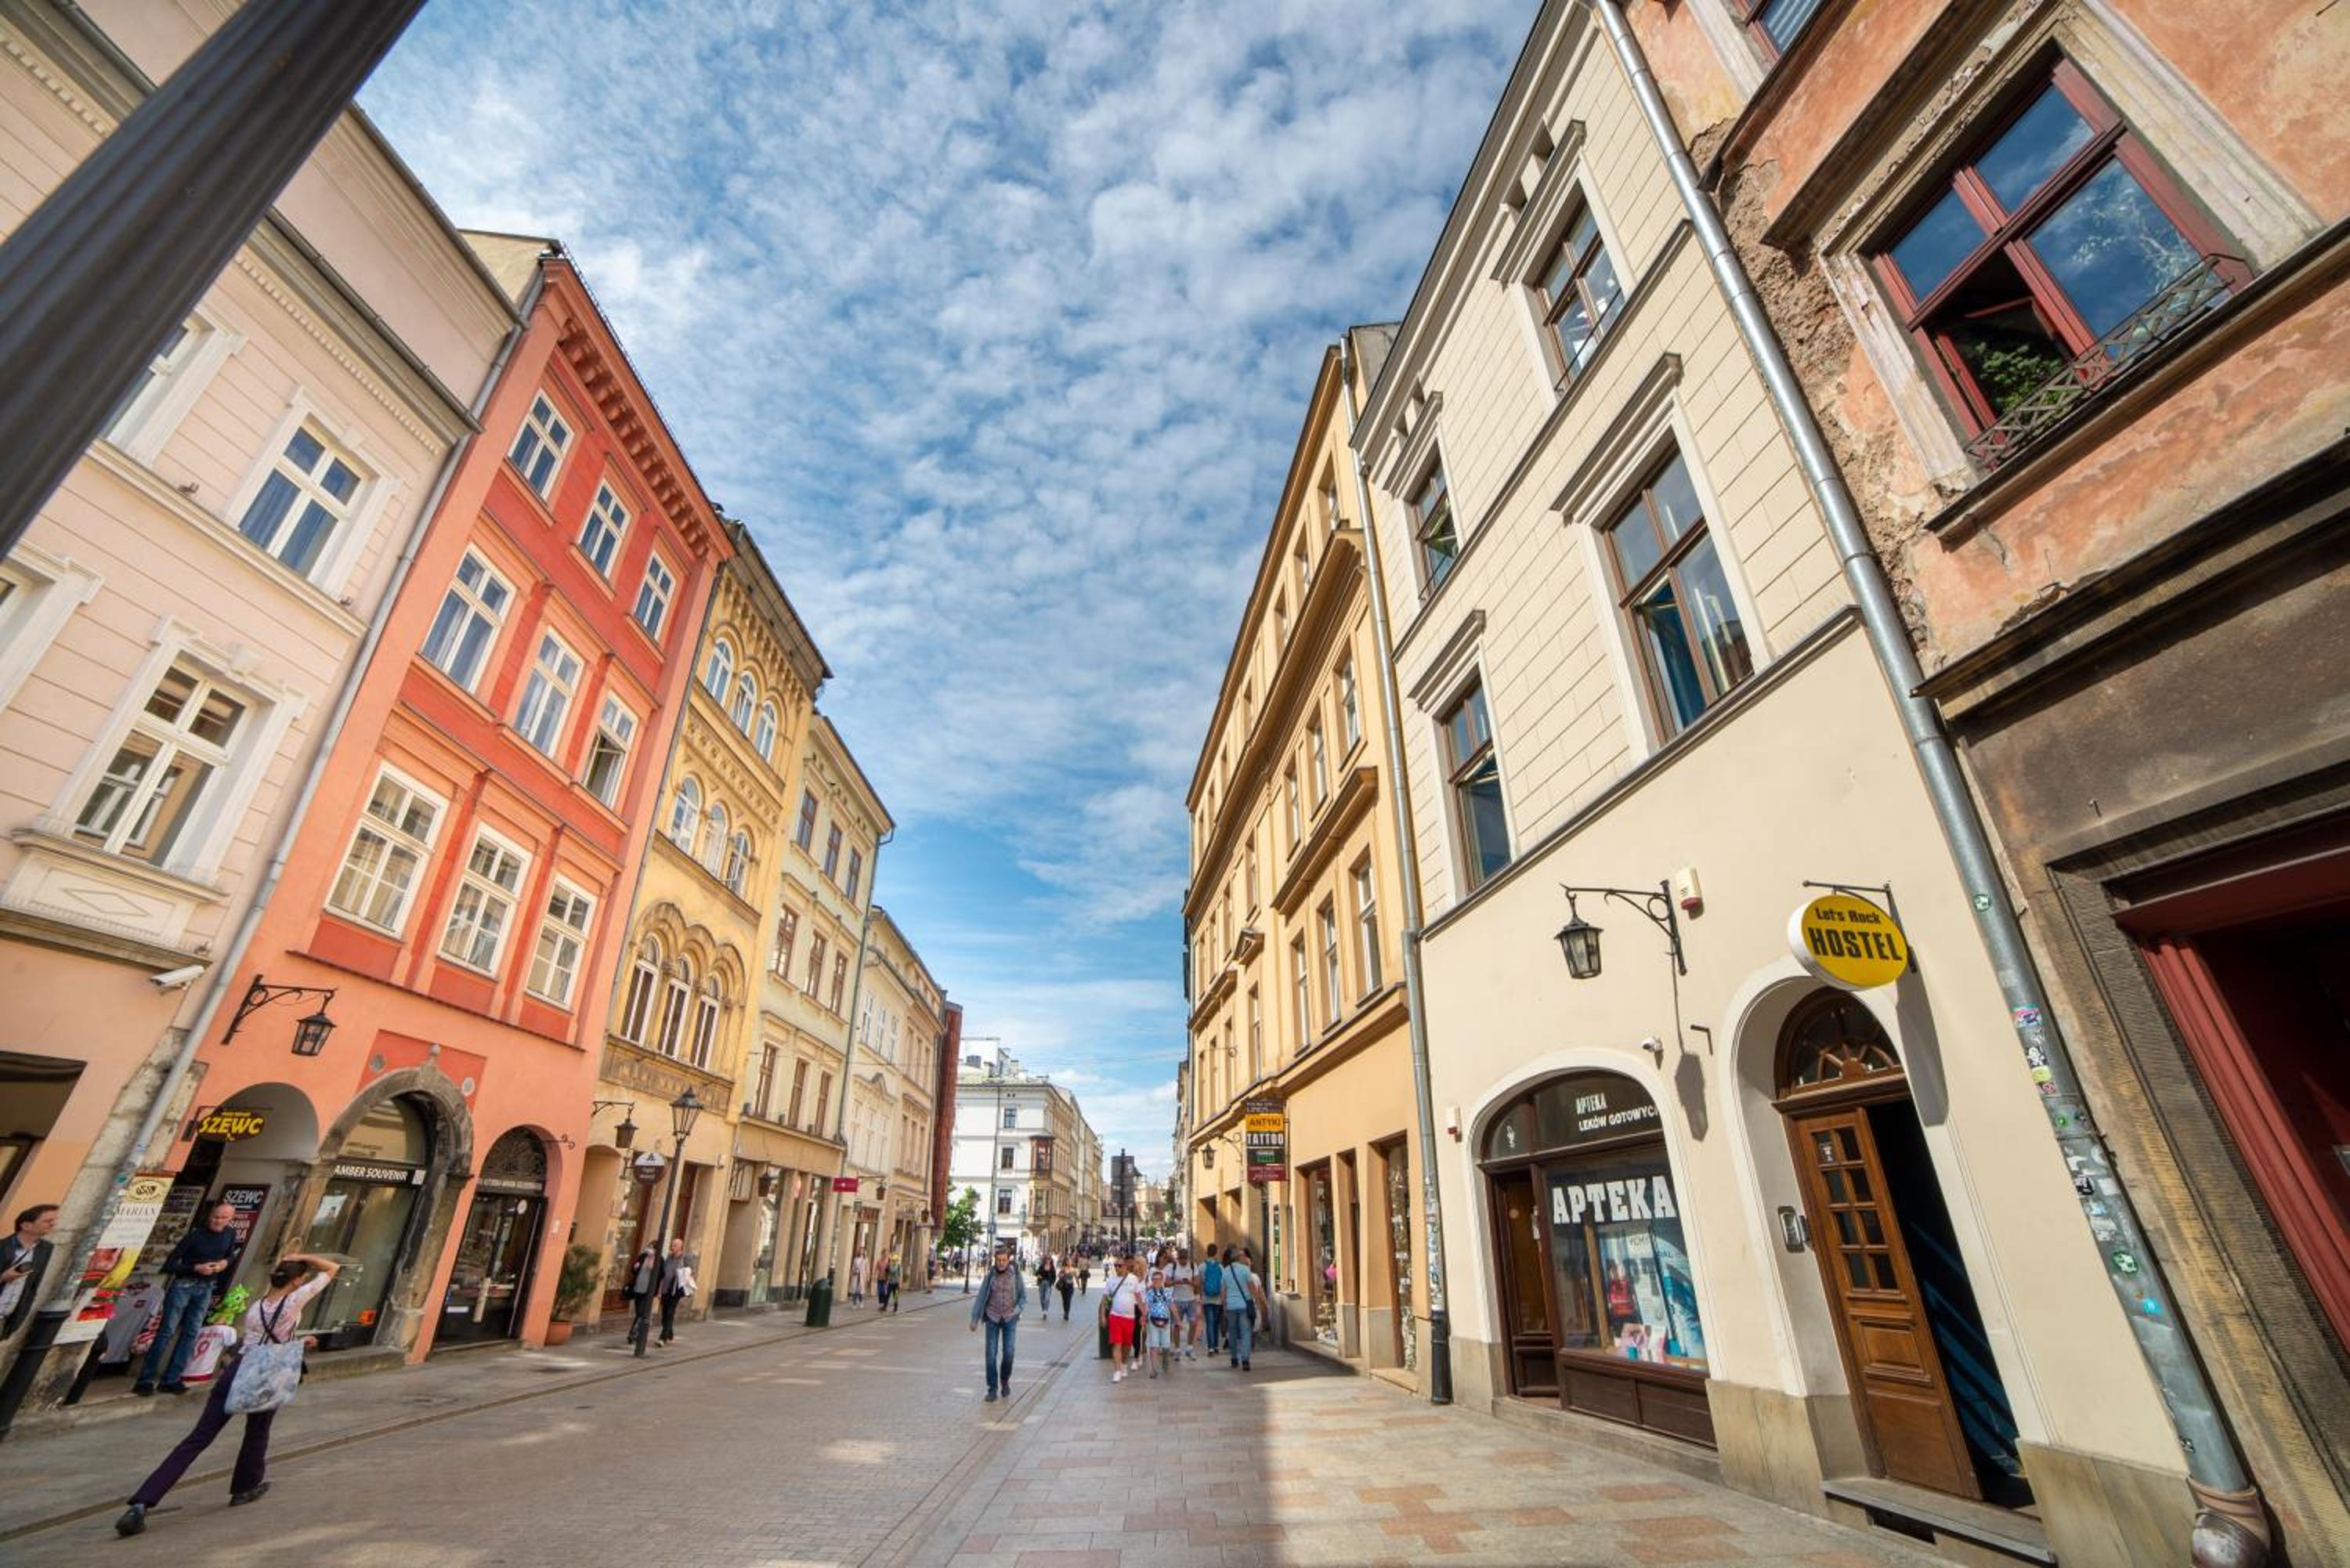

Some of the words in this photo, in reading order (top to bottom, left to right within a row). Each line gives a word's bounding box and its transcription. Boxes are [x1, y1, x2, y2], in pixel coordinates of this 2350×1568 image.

[1815, 906, 1845, 922] Let's
[1848, 909, 1882, 924] Rock
[1807, 927, 1903, 961] HOSTEL
[1575, 1093, 1607, 1115] APTEKA
[199, 1116, 264, 1135] SZEWC
[1249, 1118, 1281, 1127] ANTYKI
[1246, 1133, 1284, 1145] TATTOO
[332, 1165, 366, 1177] AMBER
[365, 1168, 408, 1181] SOUVENIR
[223, 1190, 264, 1203] SZEWC
[1552, 1175, 1678, 1224] APTEKA
